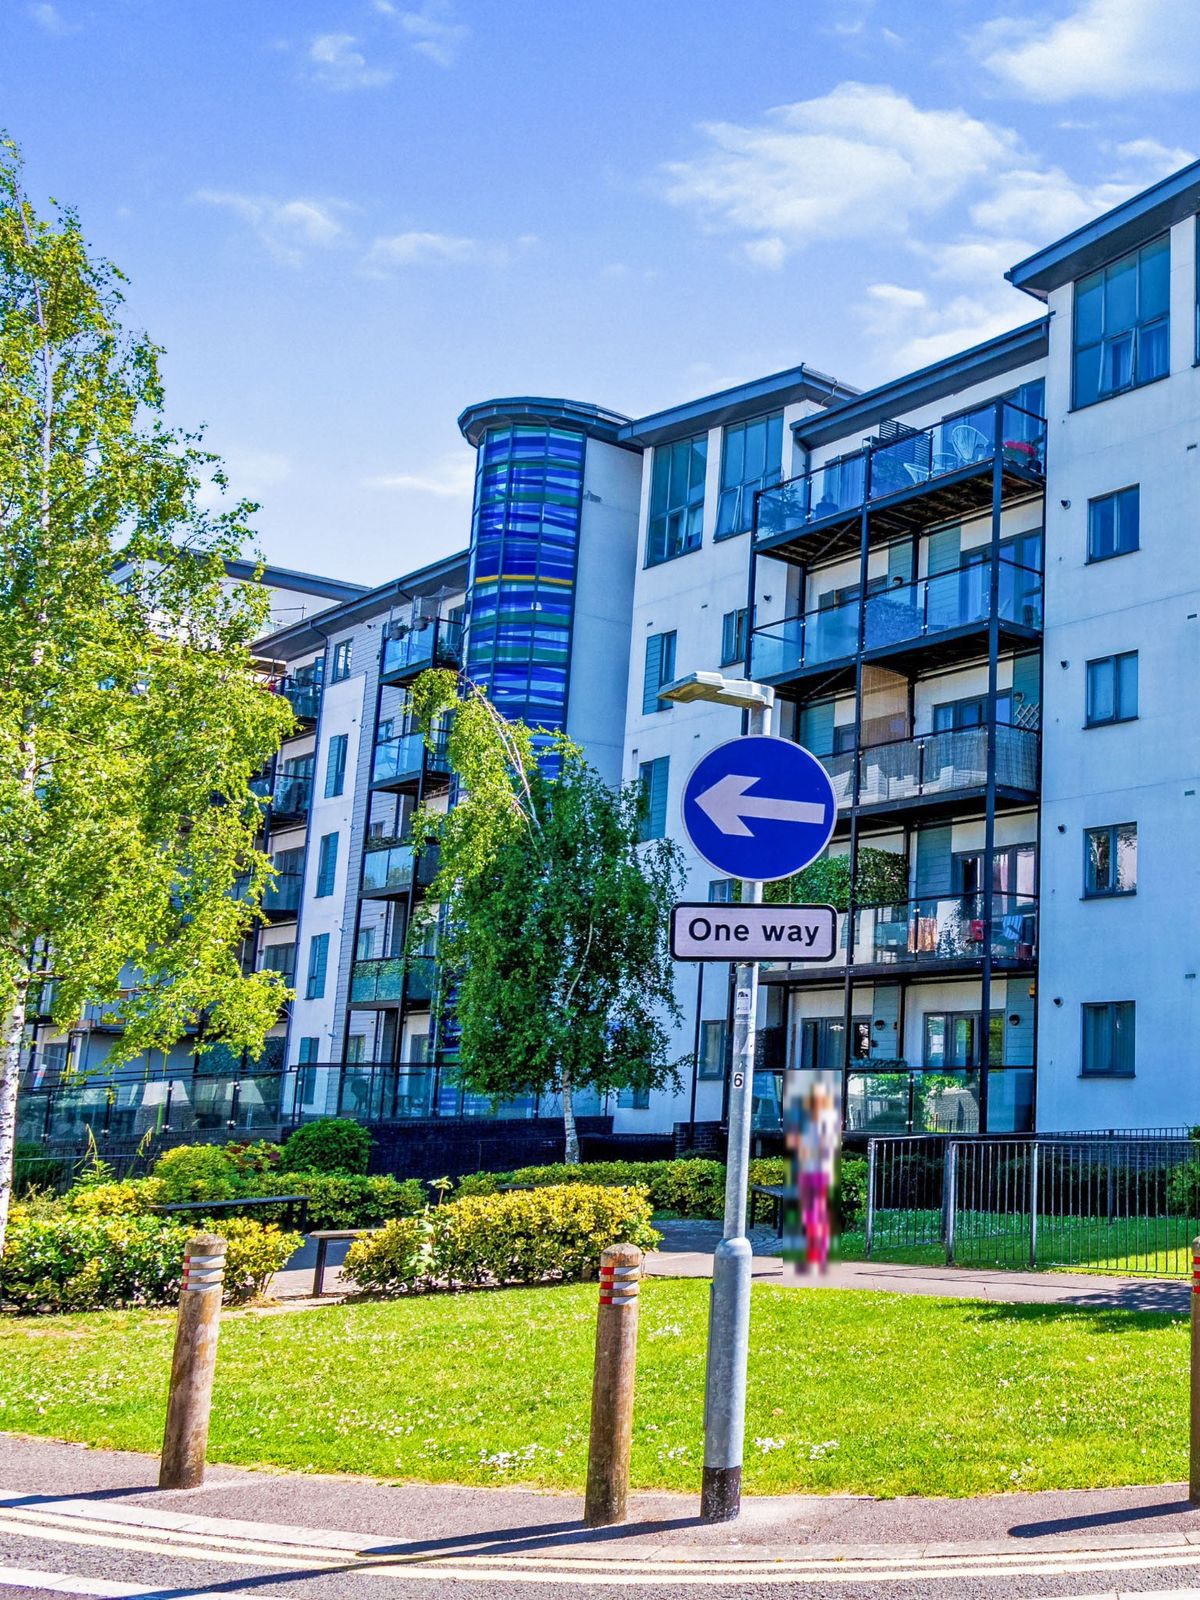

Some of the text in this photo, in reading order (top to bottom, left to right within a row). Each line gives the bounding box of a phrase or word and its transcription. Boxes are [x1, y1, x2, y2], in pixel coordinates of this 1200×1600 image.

[688, 917, 820, 947] One way
[733, 1073, 743, 1088] 6
